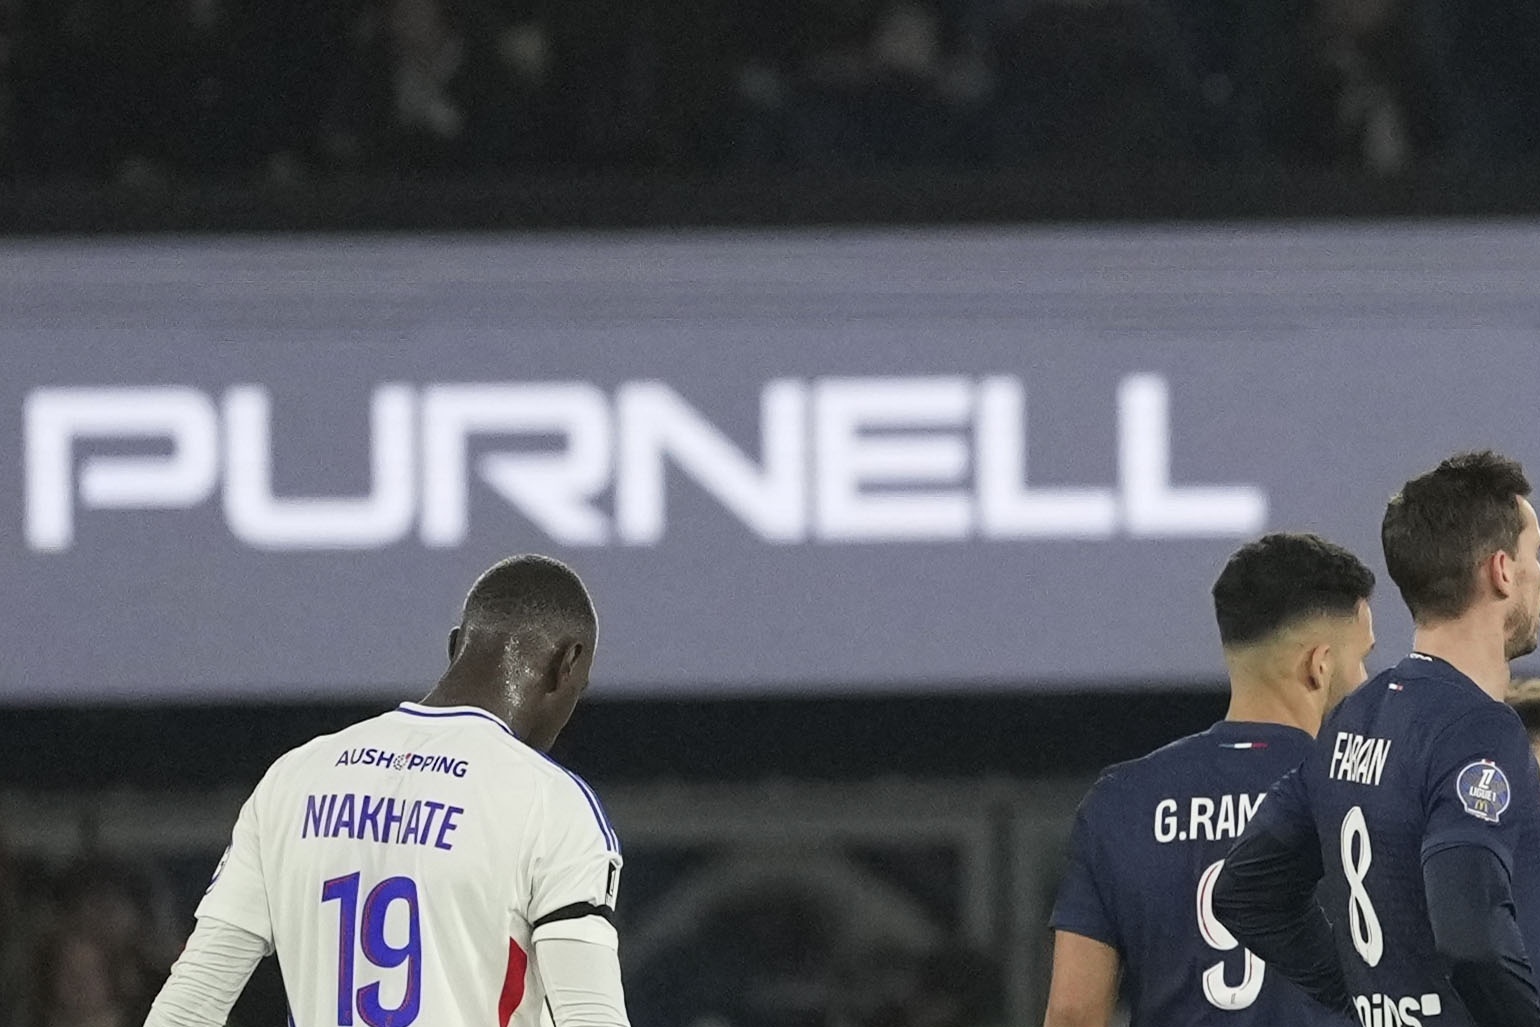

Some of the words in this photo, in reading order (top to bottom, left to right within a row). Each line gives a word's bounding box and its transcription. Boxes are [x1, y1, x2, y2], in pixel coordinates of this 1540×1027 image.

[24, 372, 1266, 551] PURNELL
[302, 793, 464, 850] NIAKHATE
[1340, 806, 1384, 968] 8
